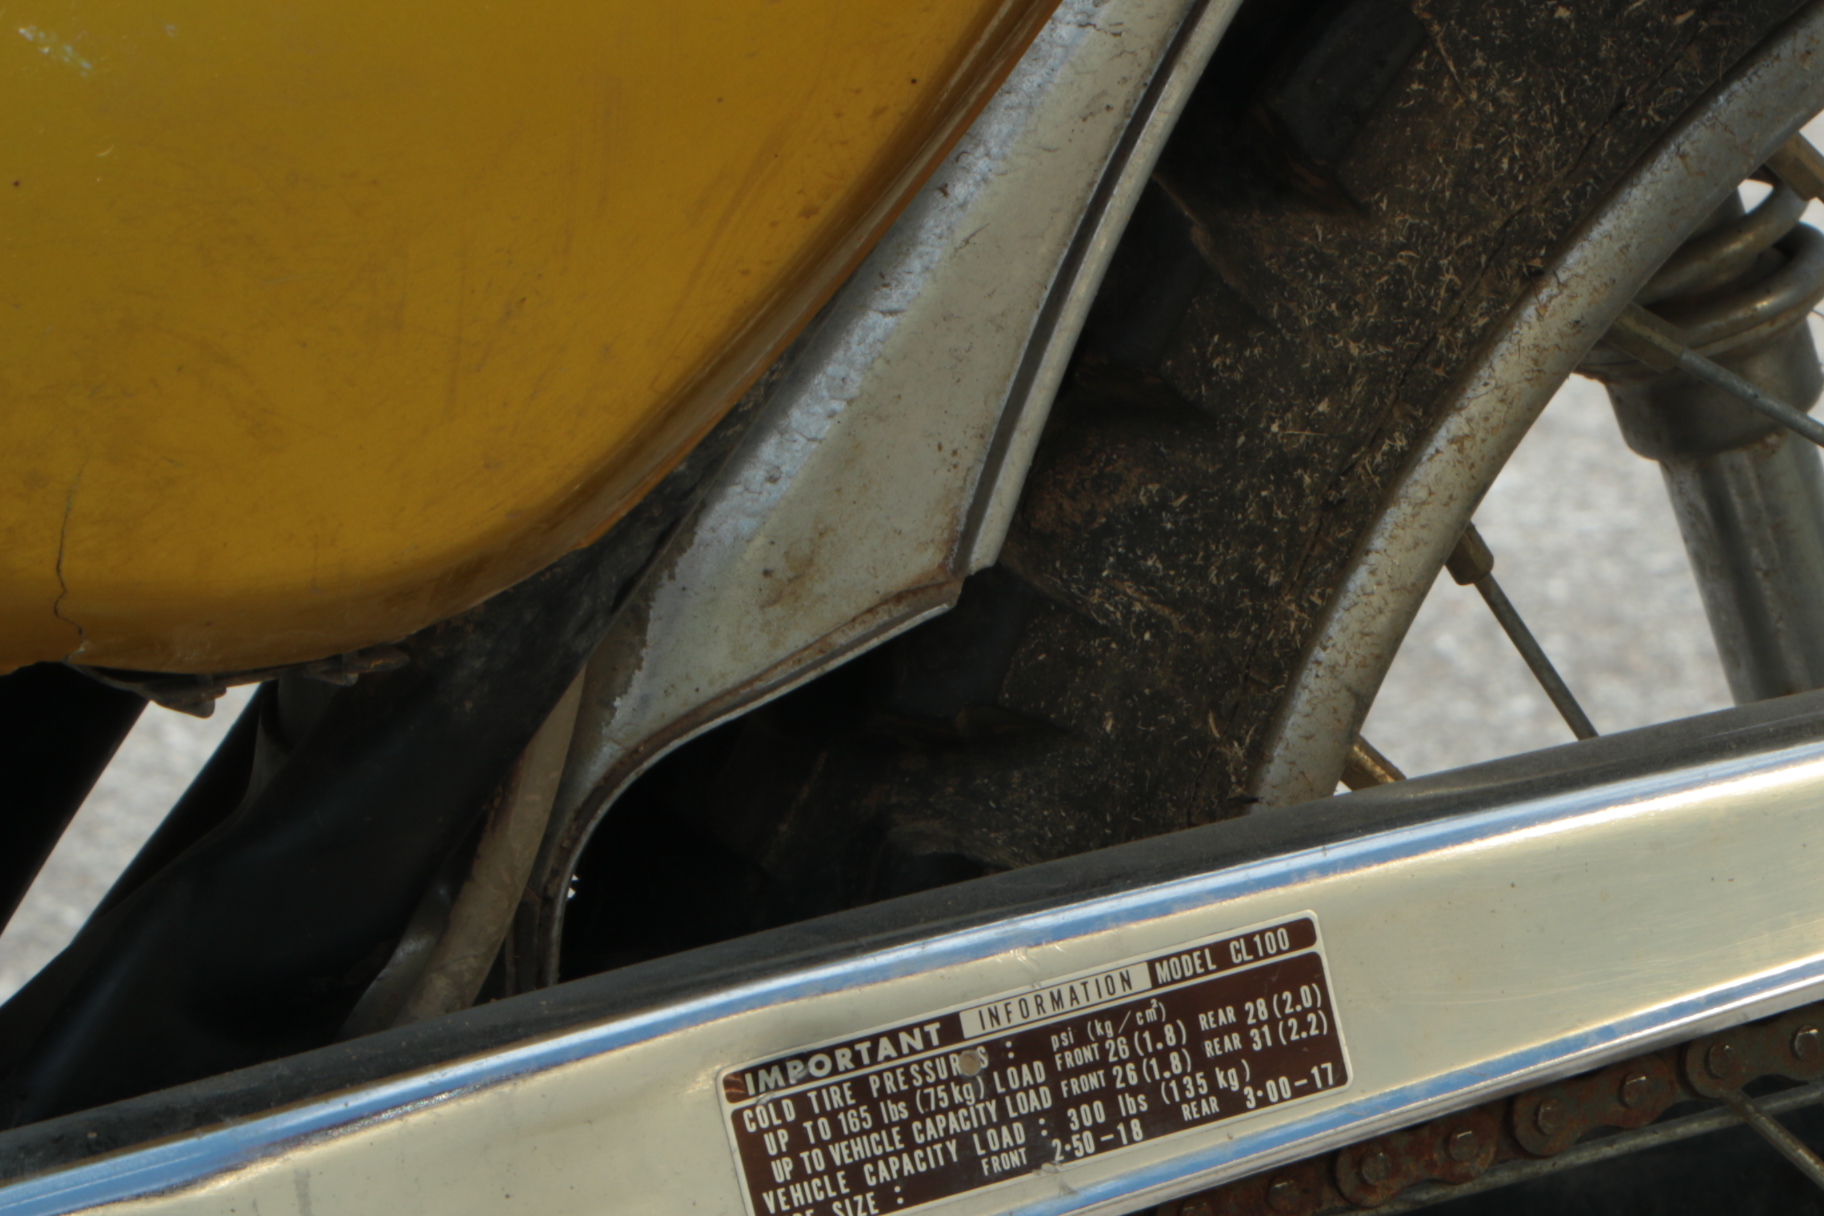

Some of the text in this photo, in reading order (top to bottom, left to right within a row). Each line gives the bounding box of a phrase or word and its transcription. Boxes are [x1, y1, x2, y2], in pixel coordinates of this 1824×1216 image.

[745, 927, 1290, 1096] IMPORTANT INFORMATION MODEL CL100
[743, 1099, 796, 1133] COLD
[807, 1082, 856, 1114] TIRE
[869, 1045, 989, 1098] PRESSURS
[1051, 1027, 1074, 1052] psi
[764, 1129, 789, 1156] UP
[803, 1117, 832, 1144] TO
[838, 1105, 873, 1135] 165
[880, 1100, 909, 1125] lbs
[993, 1061, 1047, 1094] LOAD
[1055, 1043, 1100, 1072] FRONT
[1199, 1006, 1237, 1031] REAR
[771, 1157, 794, 1183] UP
[800, 1148, 826, 1175] TO
[829, 1125, 905, 1167] VEHICLE
[912, 1099, 998, 1144] CAPACITY
[1005, 1086, 1053, 1118] LOAD
[1061, 1069, 1106, 1098] FRONT
[1204, 1033, 1242, 1058] REAR
[981, 1147, 1028, 1176] FRONT
[1181, 1096, 1220, 1122] REAR
[762, 1171, 851, 1214] VEHICLE
[863, 1139, 958, 1187] CAPACITY
[973, 1122, 1026, 1156] LOAD
[1067, 1100, 1106, 1131] 300
[1118, 1092, 1148, 1117] lbs
